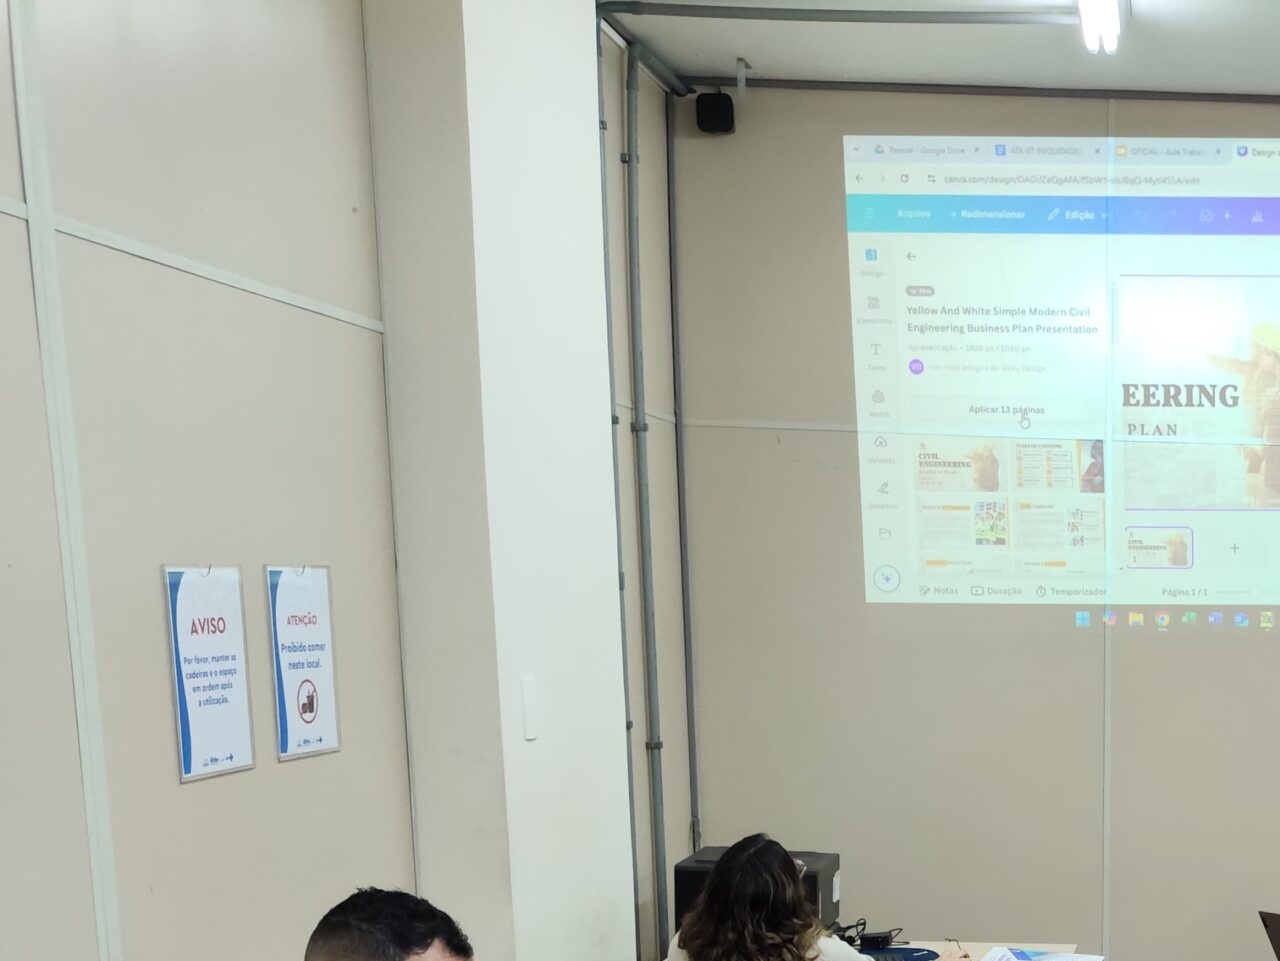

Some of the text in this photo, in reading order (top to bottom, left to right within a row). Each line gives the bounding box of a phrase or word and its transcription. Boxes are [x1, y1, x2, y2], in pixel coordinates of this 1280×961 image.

[1252, 147, 1276, 159] Design
[896, 208, 932, 221] Arquivo
[960, 208, 1026, 220] Redimensionar
[1065, 209, 1095, 222] Edição
[906, 305, 1091, 319] Yellow And White Simple Modern Civil
[907, 323, 1099, 335] Engineering Business Plan Presentation
[1121, 383, 1241, 409] EERING
[968, 405, 1046, 418] Aplicar 13 páginas
[1127, 423, 1178, 437] PLAN
[918, 452, 941, 461] CIVIL
[917, 460, 973, 469] ENGINEERING
[933, 586, 959, 596] Notas
[986, 586, 1023, 598] Duração
[1050, 586, 1107, 598] Temporizador
[1161, 587, 1190, 599] Página
[287, 611, 318, 628] ATENÇÃO
[190, 616, 226, 636] AVISO
[281, 642, 326, 653] Proibido comer
[183, 656, 193, 665] Por
[195, 655, 209, 665] favor,
[211, 655, 230, 663] manter
[288, 658, 322, 670] neste local.
[186, 671, 209, 680] cadeiras
[219, 668, 237, 678] espaço
[202, 683, 220, 692] ordem
